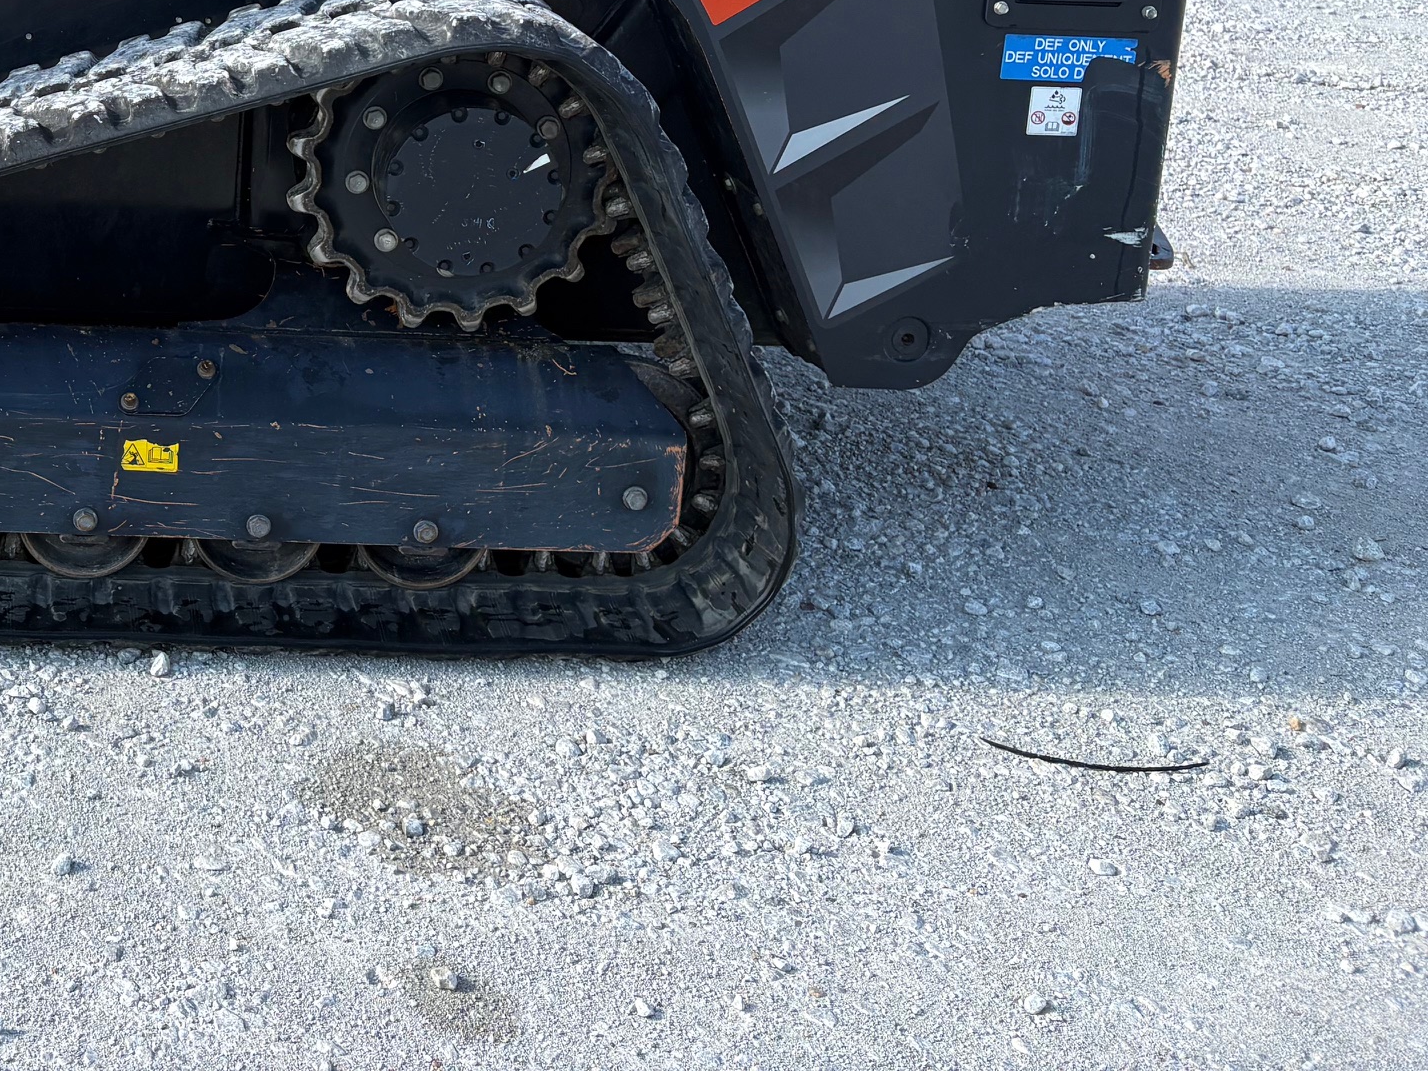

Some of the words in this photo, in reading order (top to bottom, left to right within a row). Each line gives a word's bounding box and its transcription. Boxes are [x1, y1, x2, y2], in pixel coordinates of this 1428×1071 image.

[1034, 38, 1063, 50] DEF
[1068, 39, 1106, 52] ONLY
[1005, 51, 1033, 63] DEF
[1031, 66, 1069, 79] SOLO
